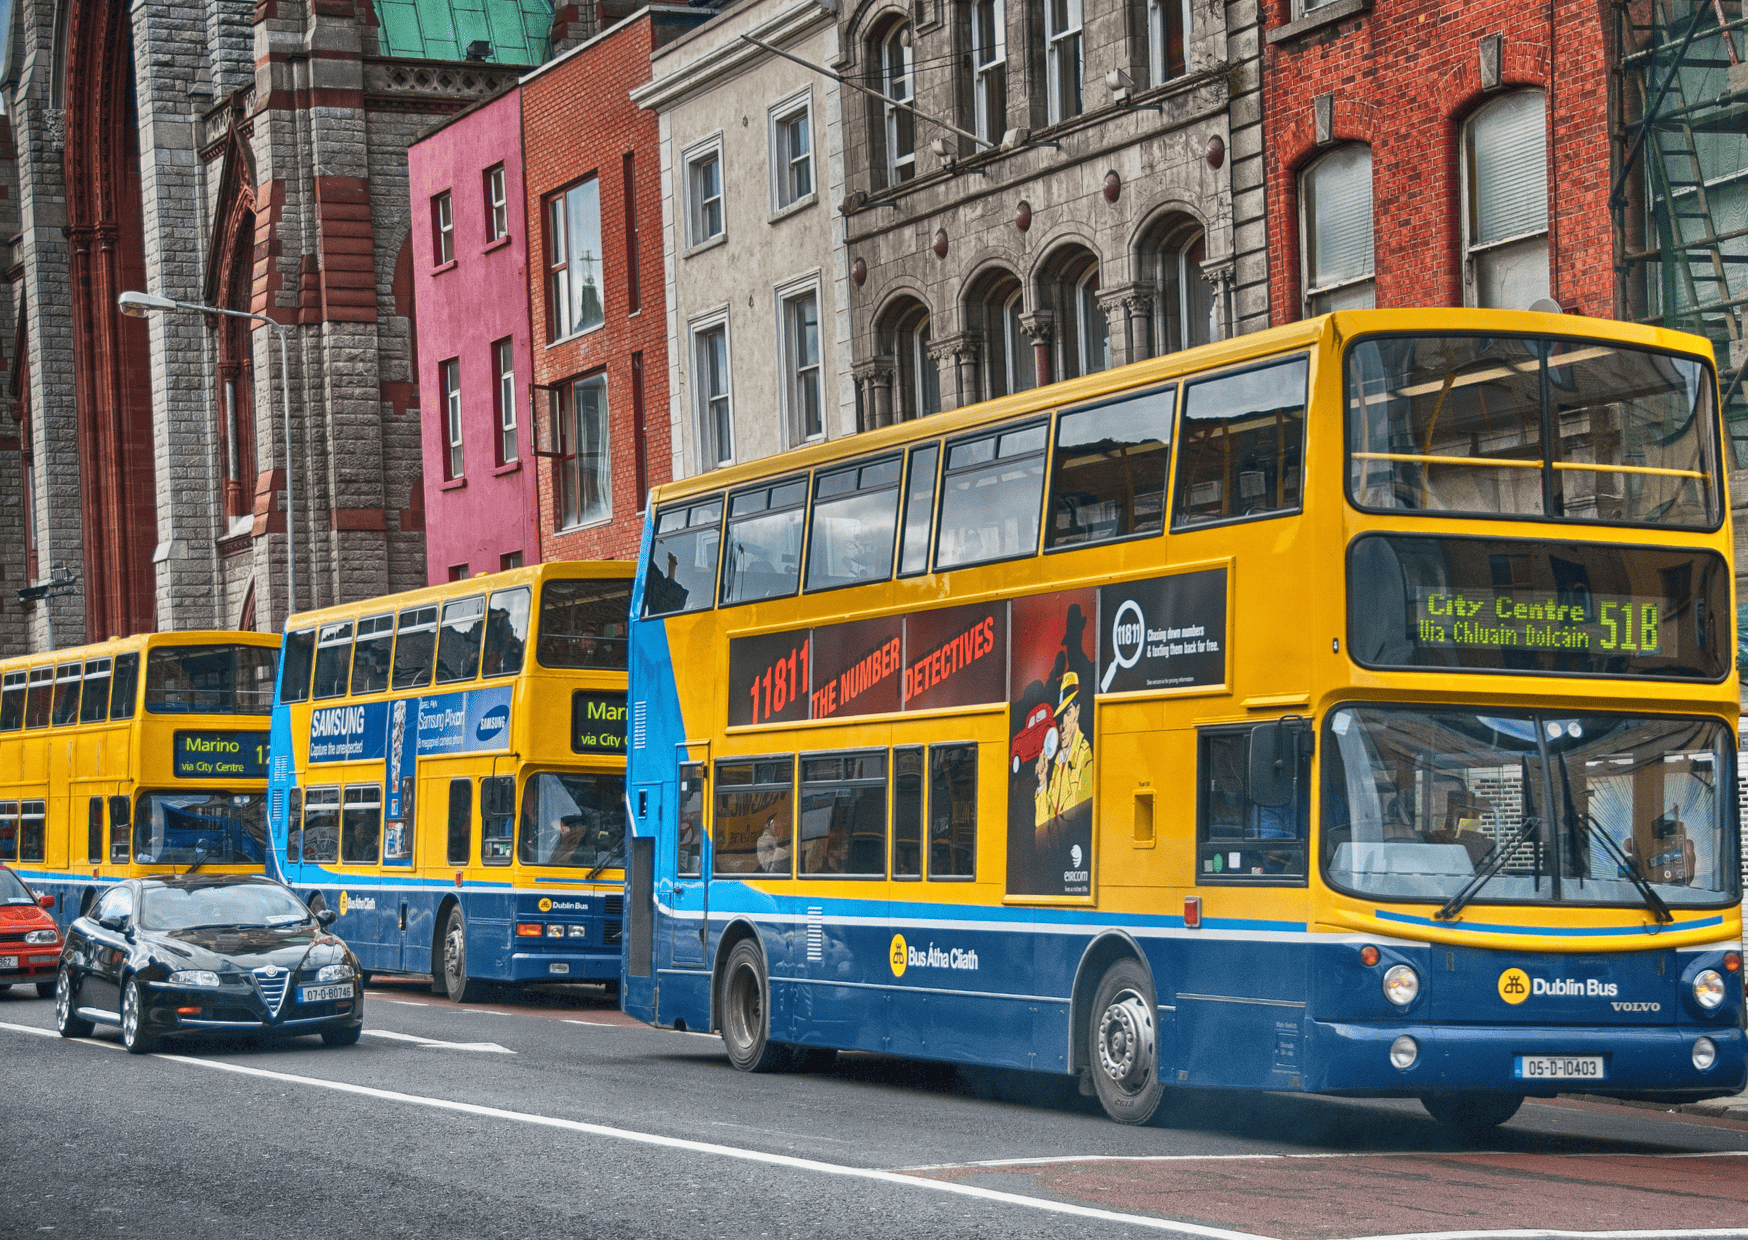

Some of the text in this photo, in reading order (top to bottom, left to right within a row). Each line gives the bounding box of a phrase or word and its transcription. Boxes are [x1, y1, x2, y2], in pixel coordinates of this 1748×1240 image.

[1427, 594, 1584, 621] City Centre
[1117, 623, 1140, 645] 11811
[1147, 624, 1204, 642] Chasing down numbers
[1419, 619, 1445, 642] Via
[1453, 620, 1517, 645] Chluain
[1600, 601, 1658, 650] 51B
[1146, 644, 1152, 658] &
[1170, 642, 1183, 656] them
[1184, 640, 1197, 654] back
[1197, 640, 1205, 653] for
[811, 616, 994, 719] THE NUMBER DETECTIVES
[751, 638, 809, 725] 11811
[312, 706, 365, 738] SAMSUNG
[418, 711, 444, 732] Samsung
[480, 715, 506, 730] SAMSUNG
[186, 738, 240, 753] Marino
[581, 732, 597, 745] via
[600, 733, 621, 748] City
[182, 761, 244, 773] via City Centre
[552, 901, 574, 909] Dublin
[908, 941, 978, 970] Bus Átha Cliath
[1532, 978, 1618, 996] Dublin Bus
[1611, 1002, 1661, 1012] VOLVO
[1529, 1060, 1596, 1076] 05-D-10403
